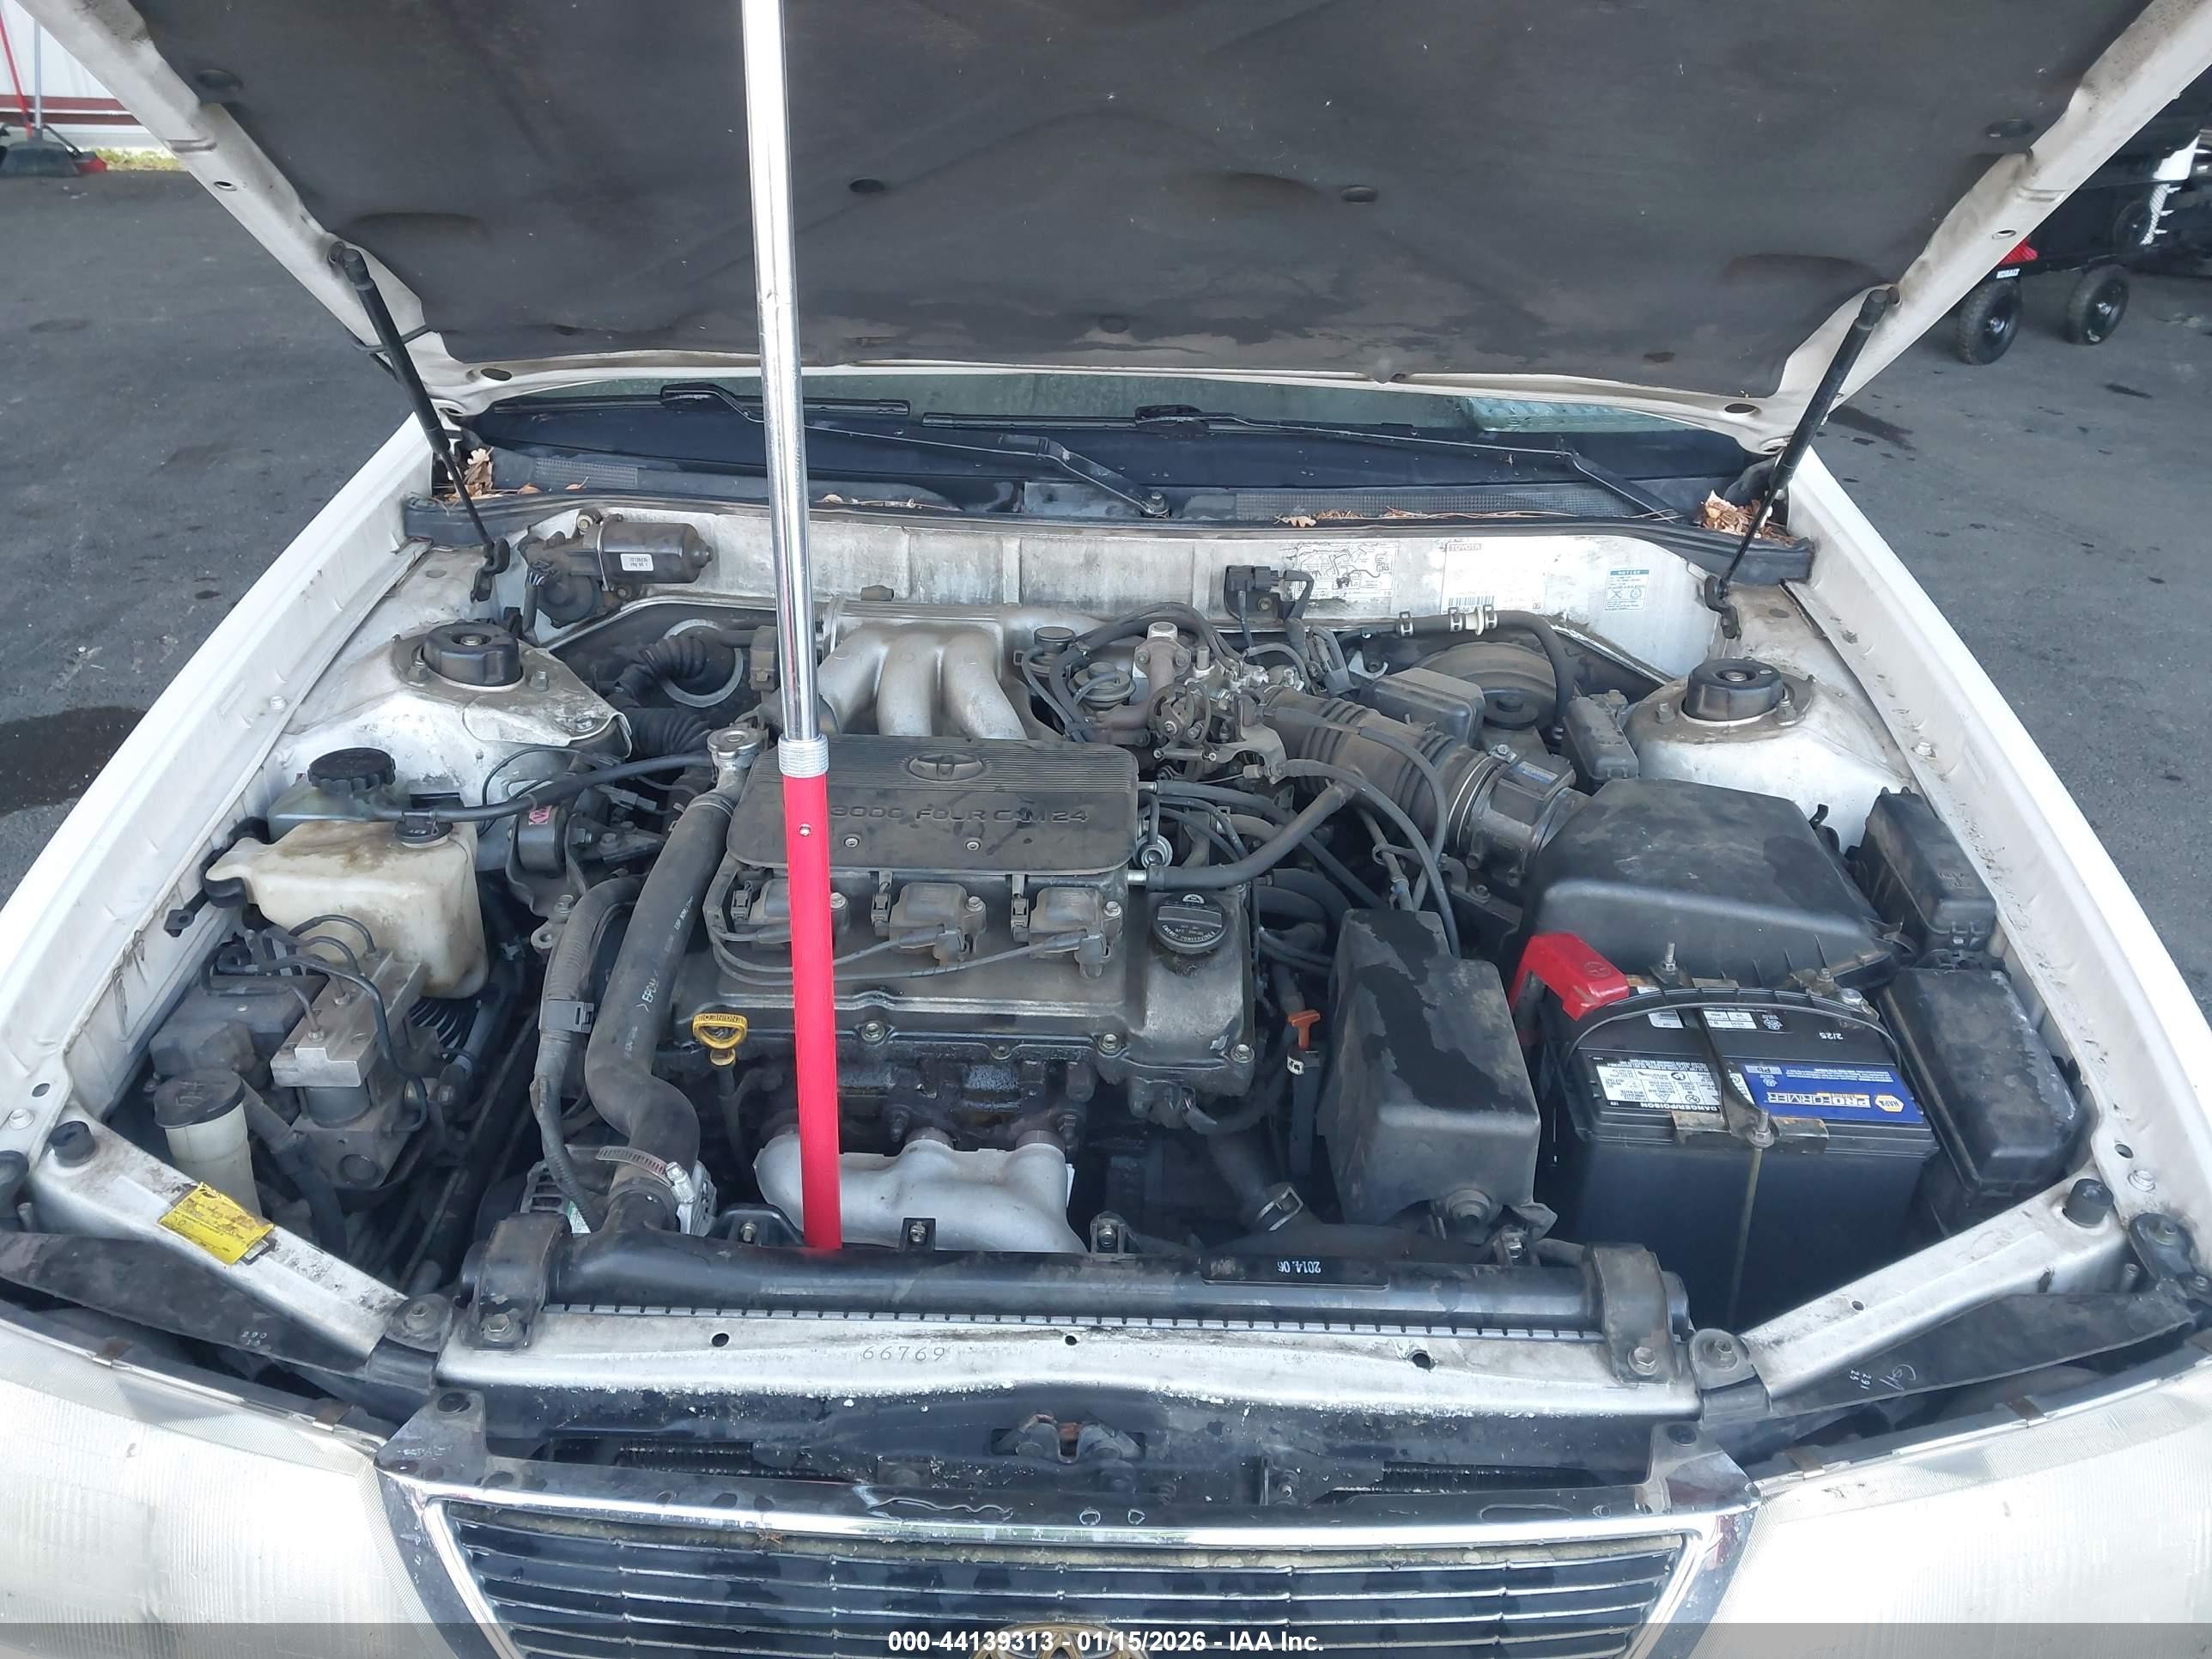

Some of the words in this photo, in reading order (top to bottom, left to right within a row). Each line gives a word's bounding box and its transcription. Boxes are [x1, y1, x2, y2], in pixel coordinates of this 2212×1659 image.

[830, 805, 904, 820] 3000
[915, 807, 988, 823] FOUR
[994, 808, 1047, 823] CAM
[1051, 810, 1088, 823] 24
[697, 1014, 711, 1023] OIL
[711, 1014, 743, 1024] ENGINE
[1819, 1031, 1844, 1041] 2/25
[1767, 1092, 1871, 1109] PROFORMER
[1879, 1099, 1900, 1108] NAPA
[861, 1345, 945, 1362] 66769
